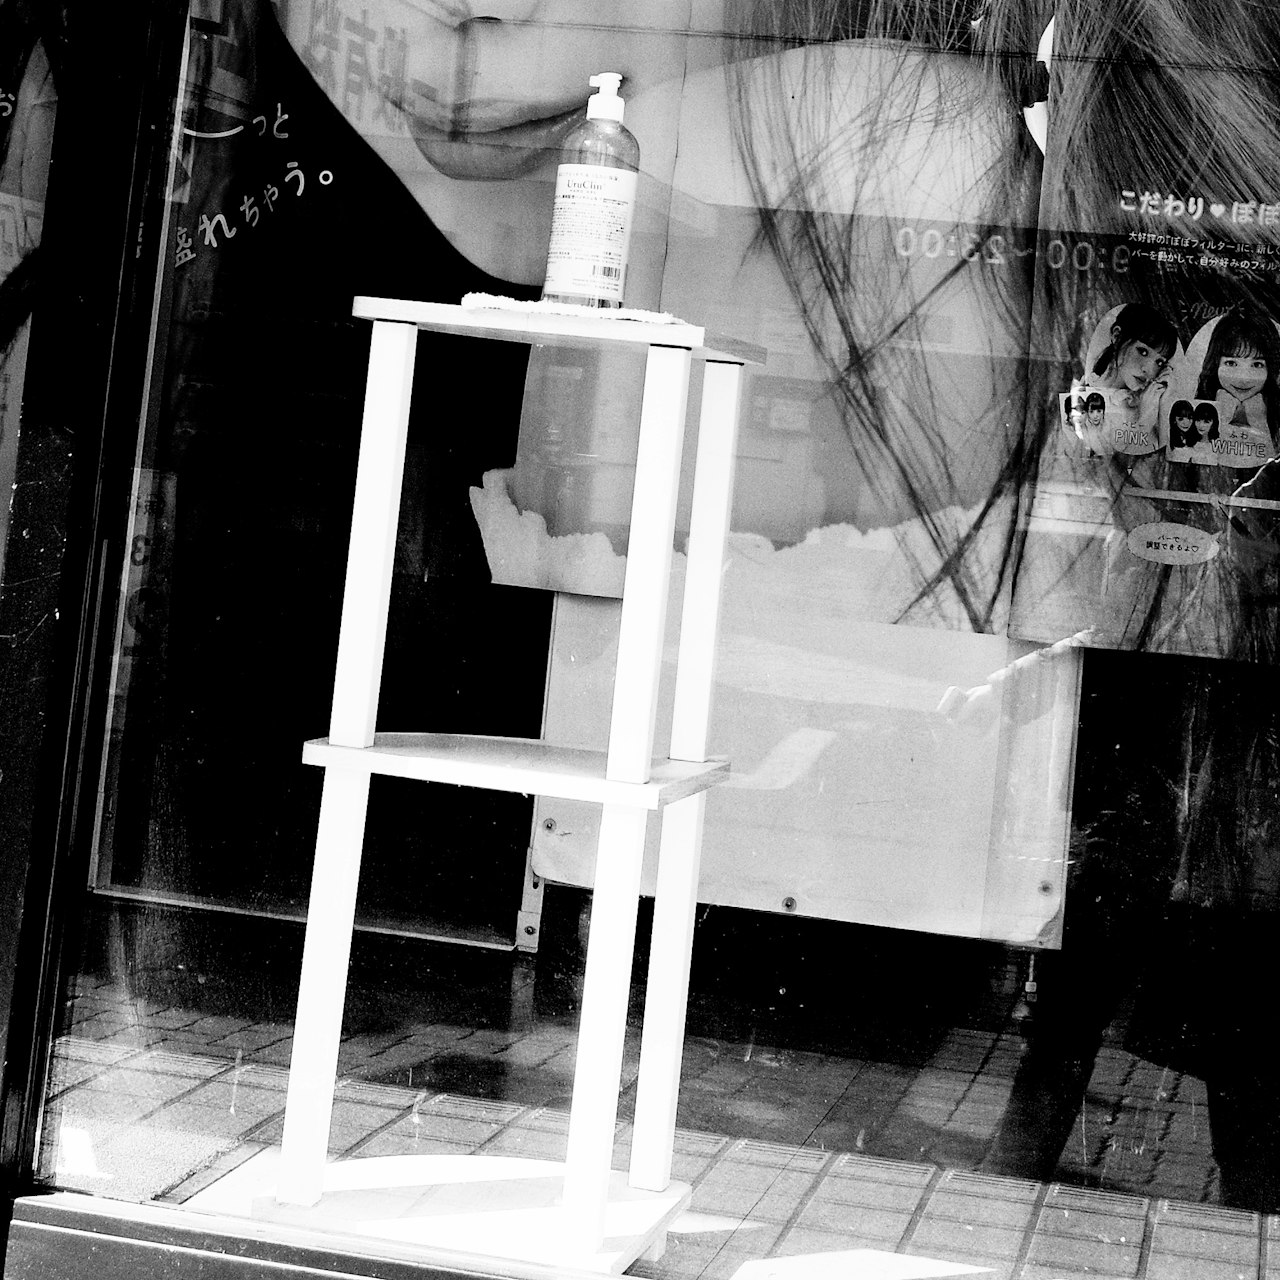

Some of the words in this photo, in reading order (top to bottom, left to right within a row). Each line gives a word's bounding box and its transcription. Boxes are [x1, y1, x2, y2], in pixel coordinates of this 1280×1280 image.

[1120, 189, 1204, 220] こだわり
[1114, 429, 1149, 447] PINK
[1211, 438, 1266, 458] WHITE
